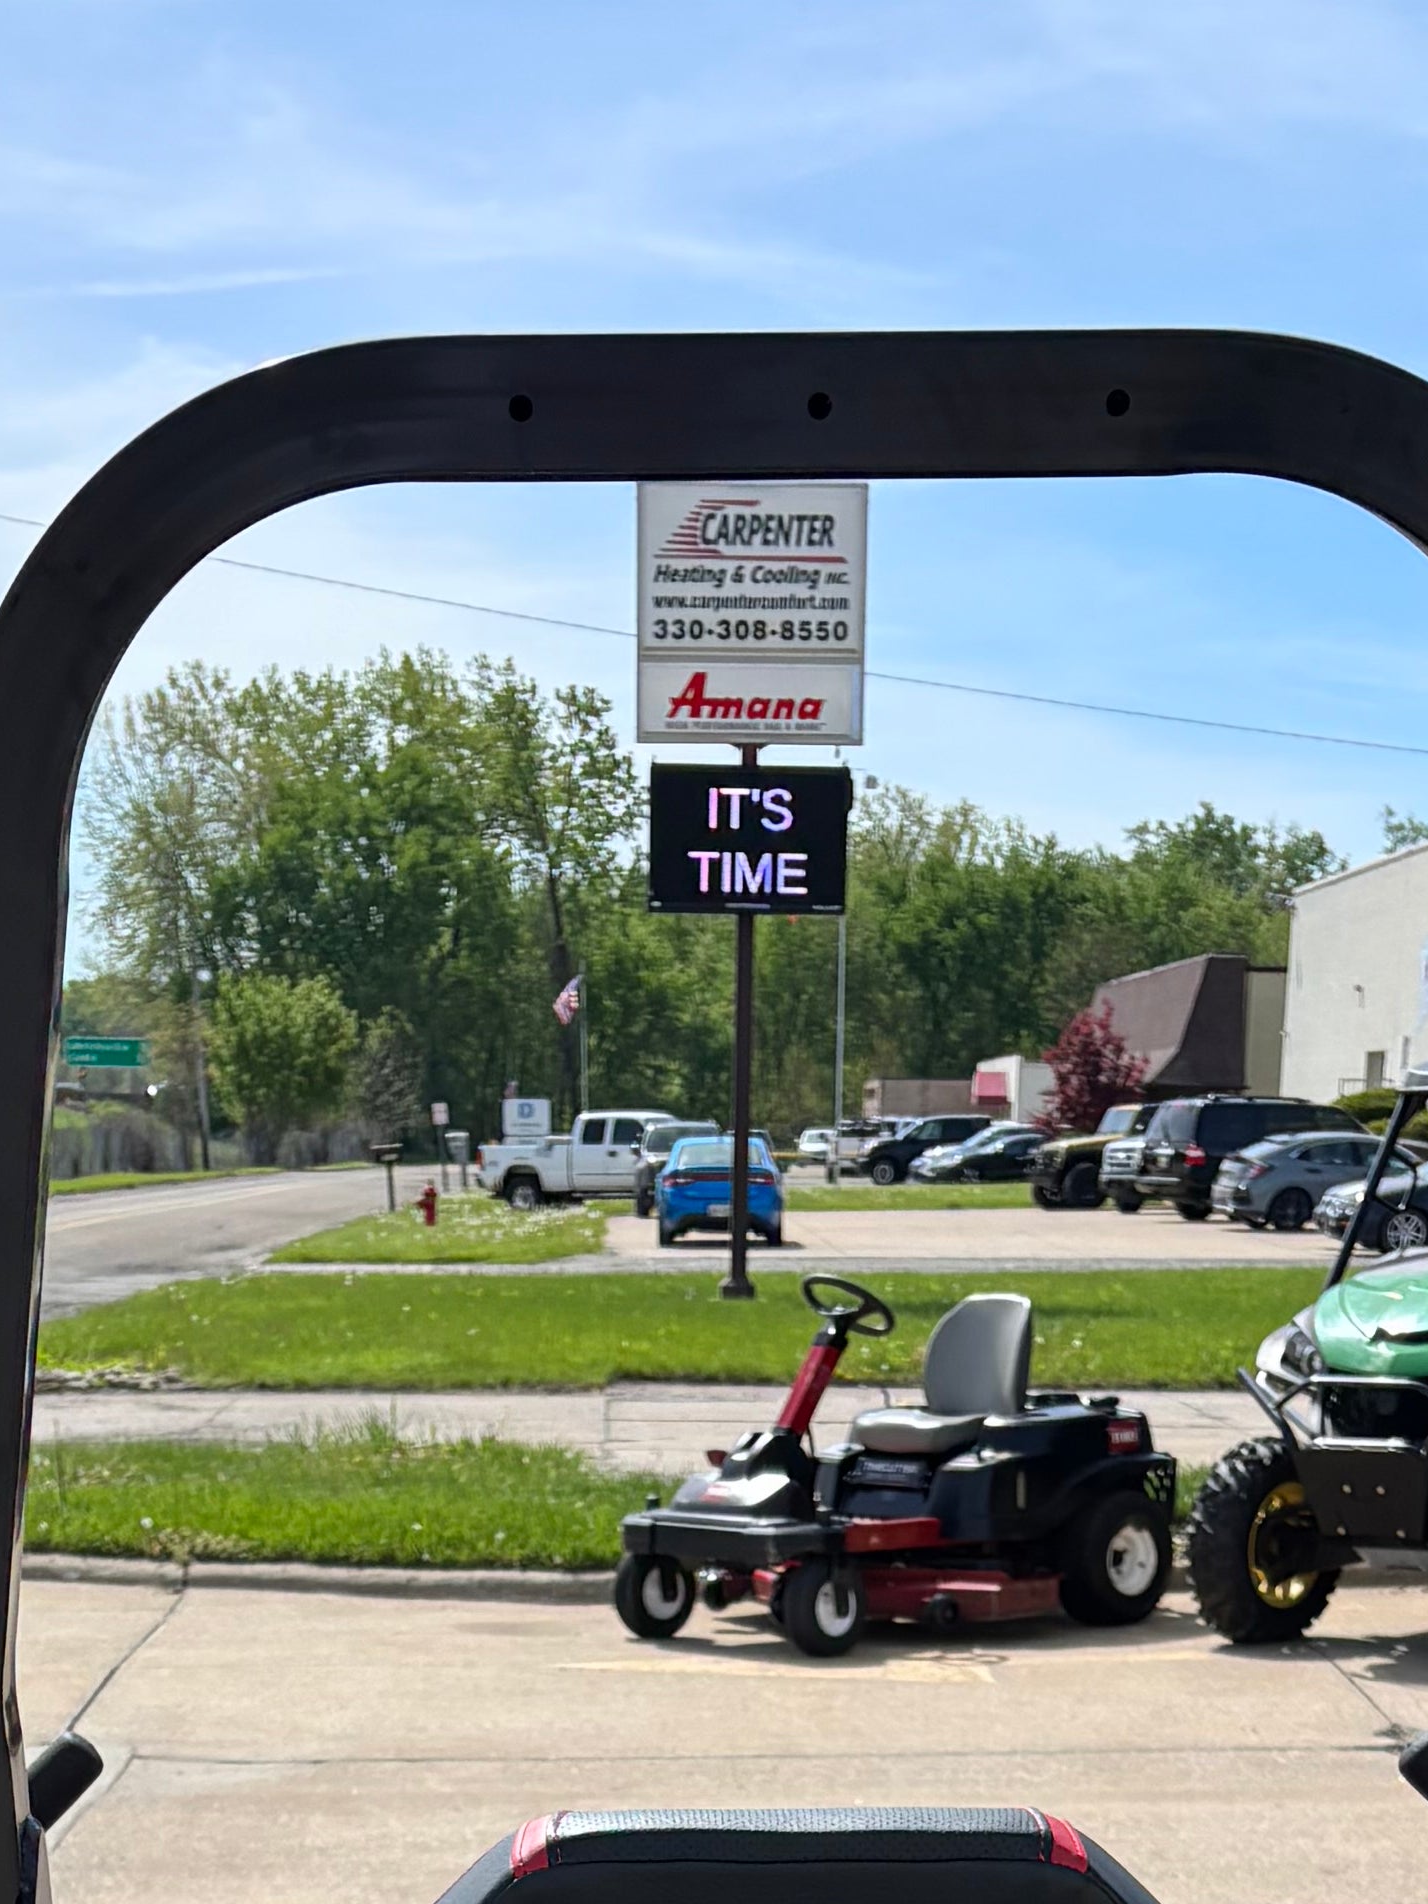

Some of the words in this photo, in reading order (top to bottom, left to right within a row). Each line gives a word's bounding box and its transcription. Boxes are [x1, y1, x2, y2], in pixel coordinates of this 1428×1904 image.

[701, 513, 835, 547] CARPENTER
[653, 564, 727, 588] Heating
[730, 565, 746, 584] &
[750, 565, 821, 589] Cooling
[666, 672, 826, 721] Amana
[707, 787, 794, 832] IT'S
[687, 851, 809, 895] TIME
